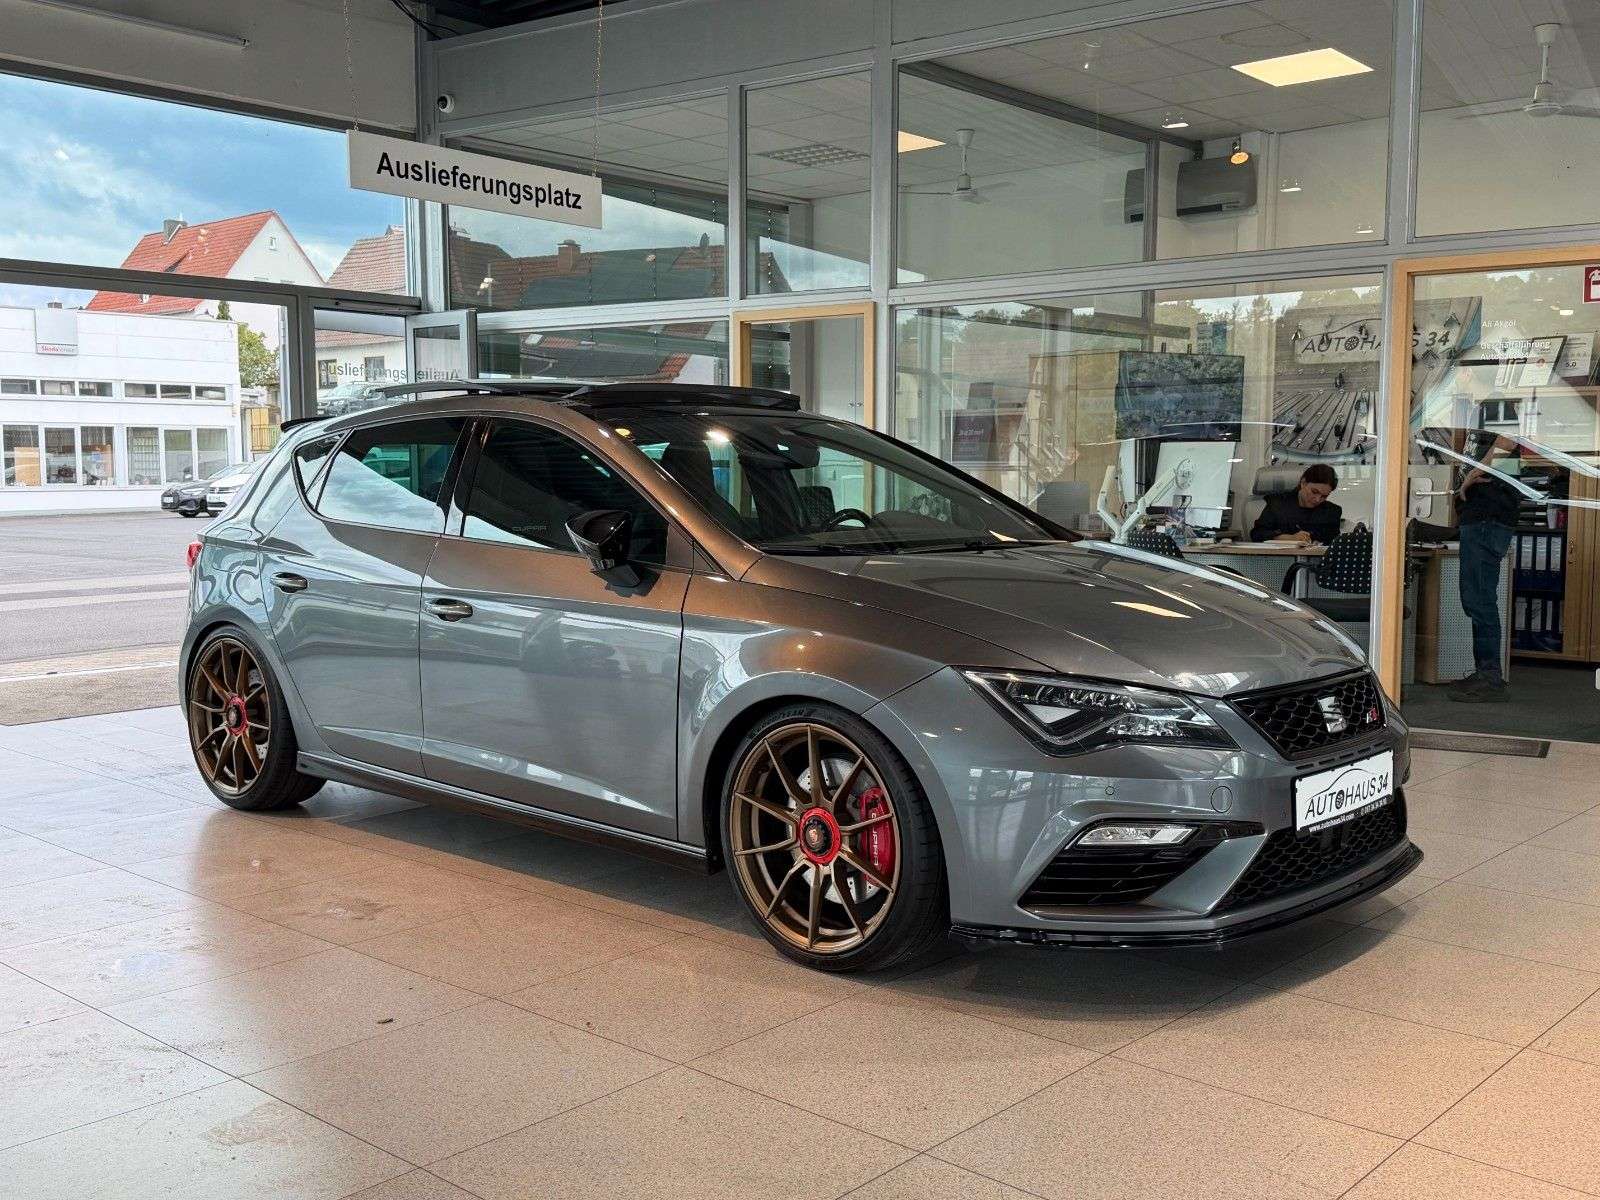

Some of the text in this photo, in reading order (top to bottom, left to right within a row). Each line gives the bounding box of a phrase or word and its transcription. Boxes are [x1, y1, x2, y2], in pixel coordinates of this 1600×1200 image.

[376, 152, 583, 210] Auslieferungsplatz
[1425, 331, 1451, 347] 34
[1305, 777, 1376, 820] AUTOHAUS
[1377, 772, 1389, 793] 34
